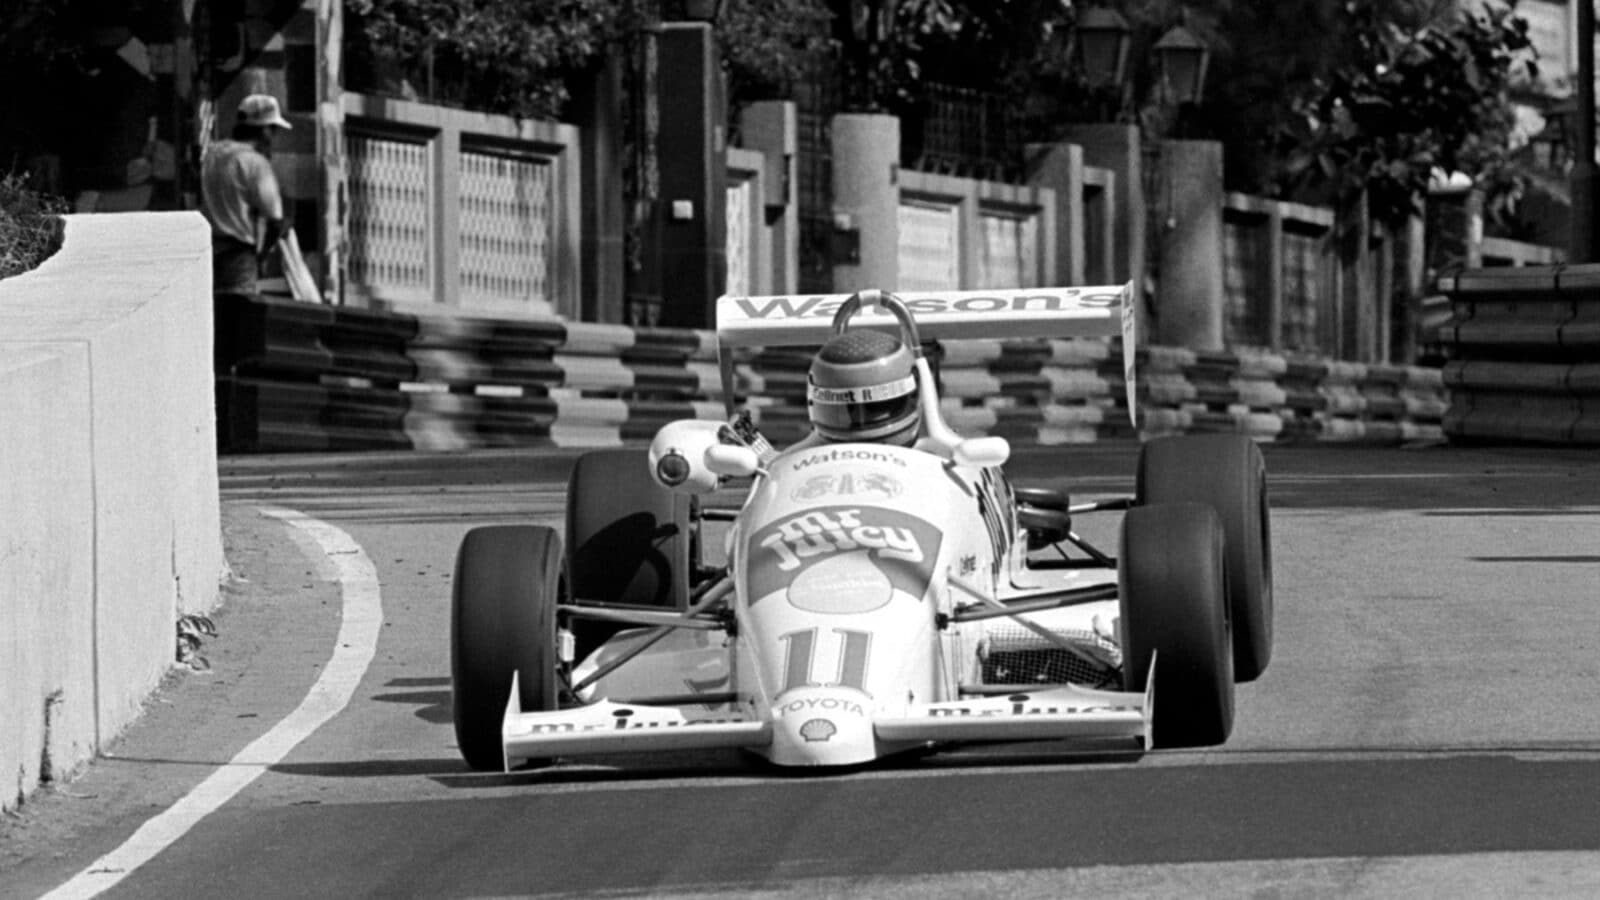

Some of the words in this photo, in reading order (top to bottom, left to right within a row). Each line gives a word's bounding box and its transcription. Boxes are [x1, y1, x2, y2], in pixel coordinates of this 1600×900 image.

[793, 449, 907, 471] Watson's
[777, 509, 862, 542] mr
[775, 626, 874, 701] 11
[777, 698, 864, 718] TOYOTA
